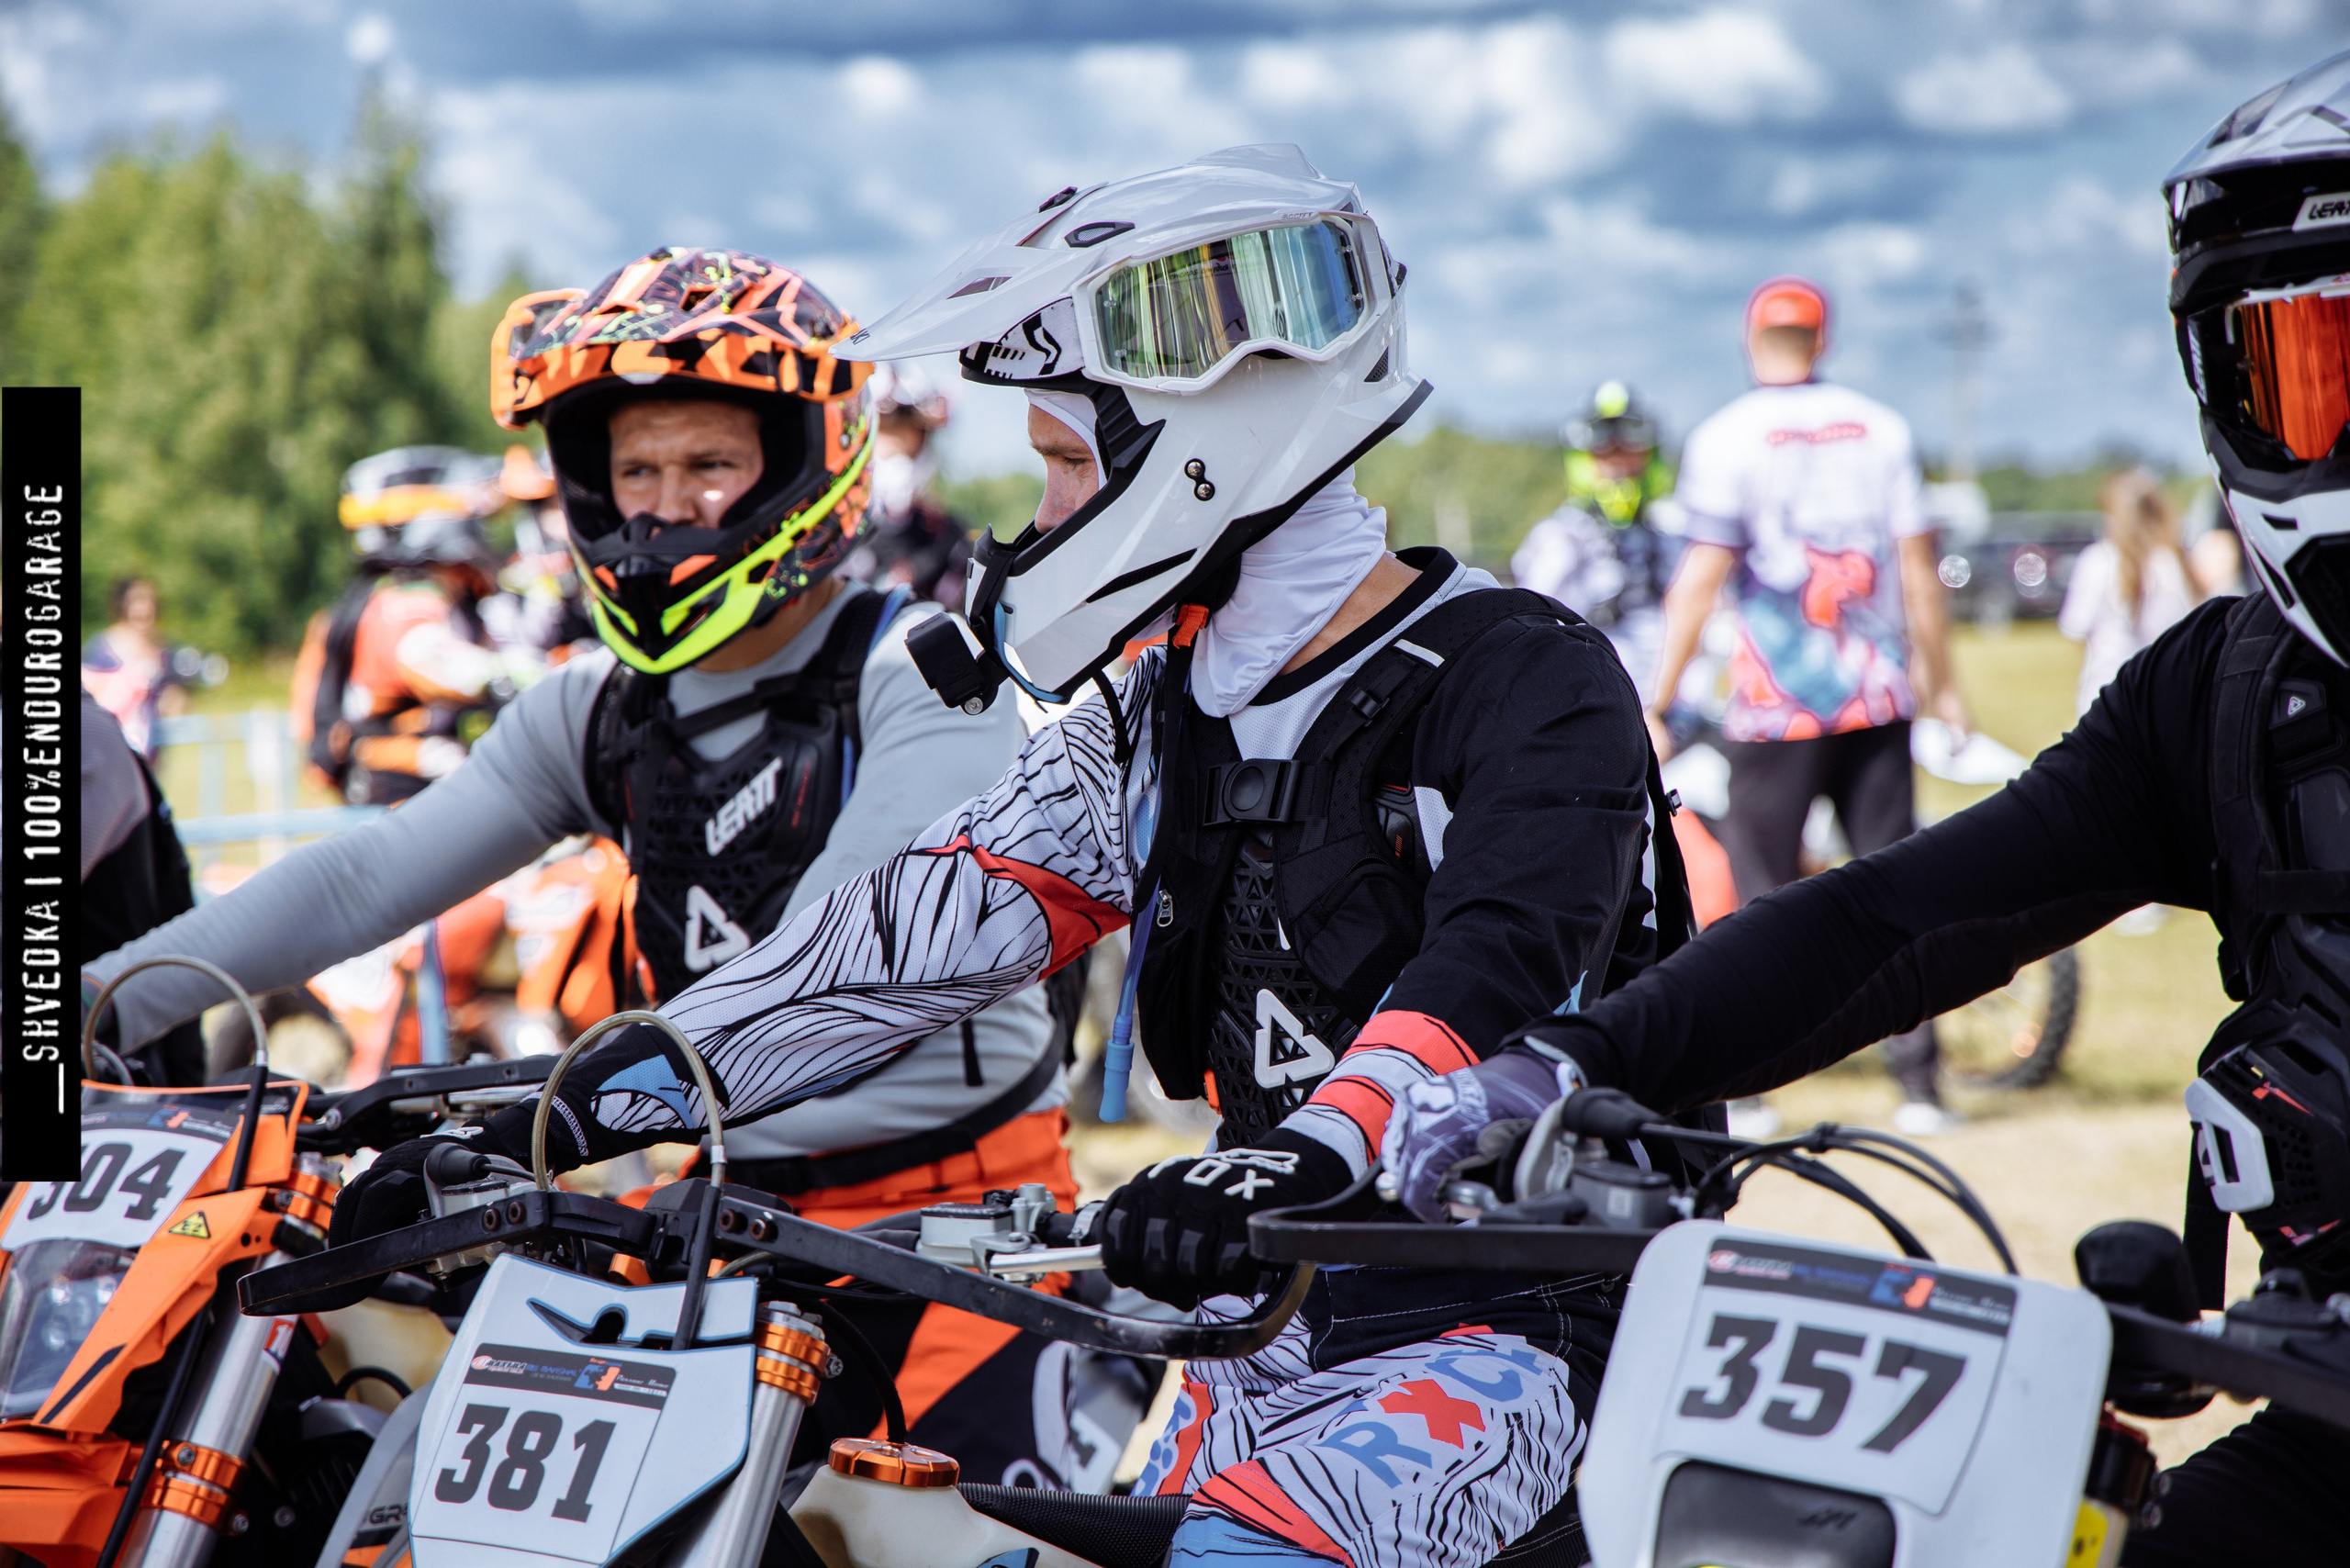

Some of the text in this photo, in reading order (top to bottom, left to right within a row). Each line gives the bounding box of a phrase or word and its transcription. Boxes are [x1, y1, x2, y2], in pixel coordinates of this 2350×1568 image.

[705, 756, 783, 857] LEATT
[1679, 1313, 1967, 1454] 357
[434, 1403, 617, 1523] 381
